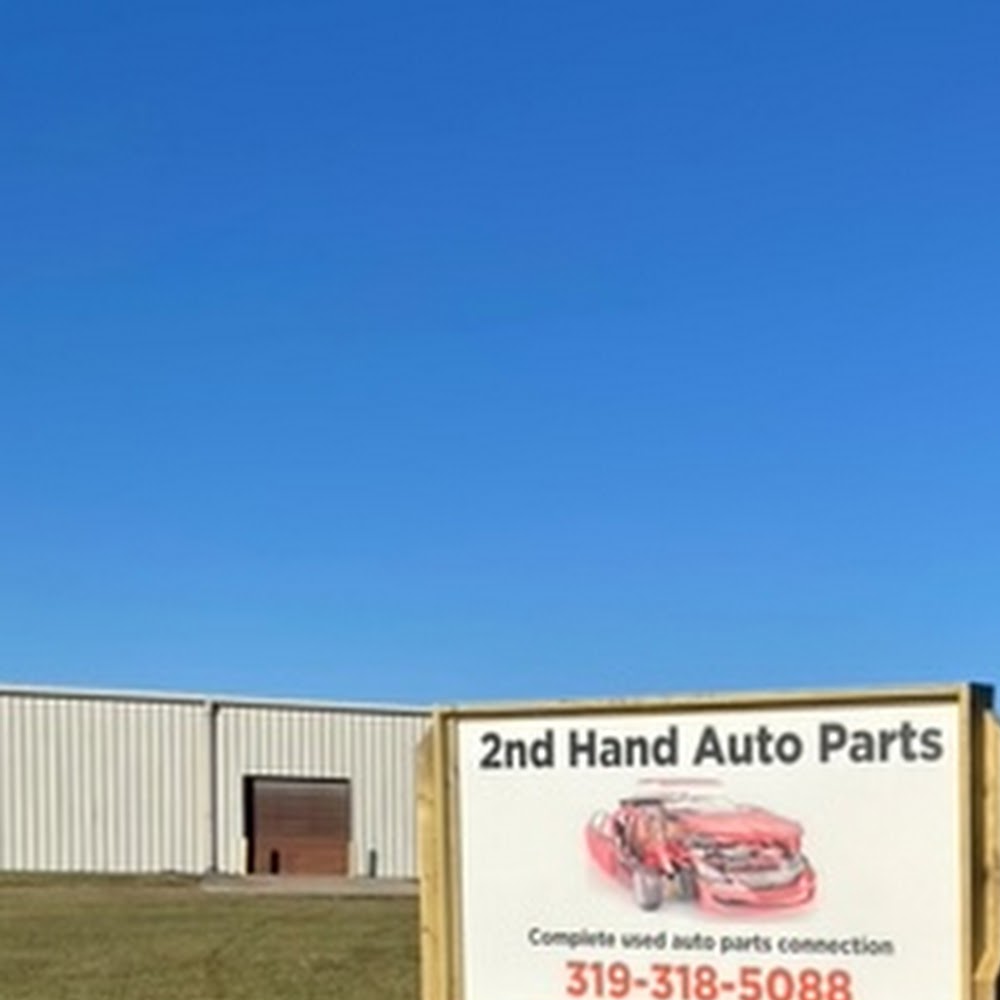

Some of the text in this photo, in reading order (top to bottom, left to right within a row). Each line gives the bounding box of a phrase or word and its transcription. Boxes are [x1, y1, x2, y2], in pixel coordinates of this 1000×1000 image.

[479, 720, 944, 769] 2nd Hand Auto Parts
[528, 927, 895, 957] Complete used auto parts connection
